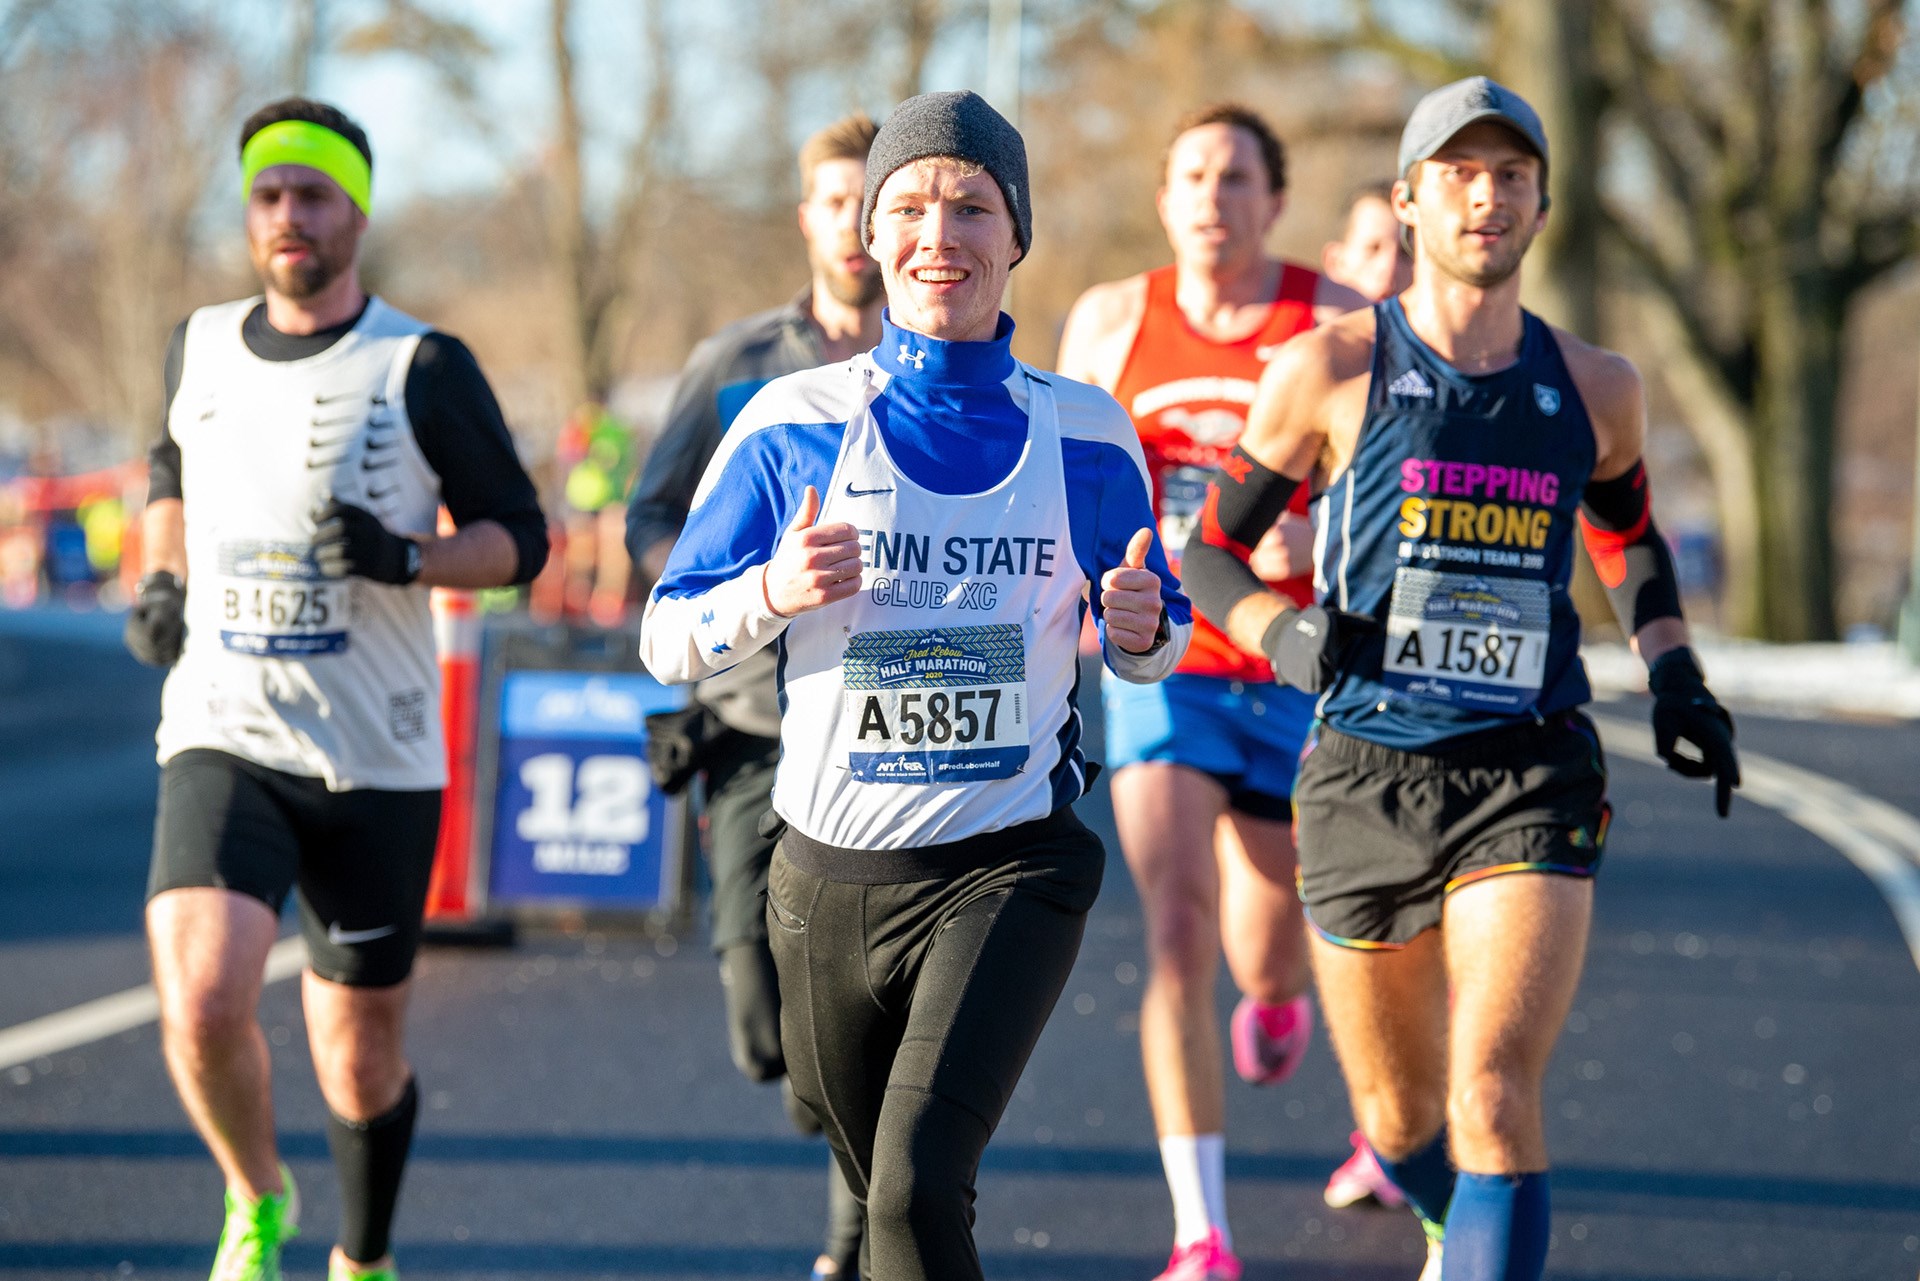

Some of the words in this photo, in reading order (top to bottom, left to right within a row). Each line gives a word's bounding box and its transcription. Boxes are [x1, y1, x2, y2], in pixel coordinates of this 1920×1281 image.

[1400, 457, 1560, 506] STEPPING
[1397, 496, 1552, 549] STRONG
[857, 529, 930, 573] ENN
[943, 536, 1056, 577] STATE
[1482, 549, 1521, 567] TEAM
[225, 588, 240, 620] B
[871, 577, 949, 609] CLUB
[958, 582, 998, 611] XC
[880, 661, 912, 678] HALF
[915, 658, 987, 673] MARATHON
[904, 647, 931, 661] Fred
[930, 645, 963, 658] Lebow
[1396, 630, 1423, 667] A
[1437, 629, 1524, 679] 1587
[925, 671, 943, 679] 2020
[857, 695, 891, 740] A
[900, 689, 1001, 745] 5857
[938, 760, 1000, 771] #FredLebowHalf
[516, 753, 650, 844] 12
